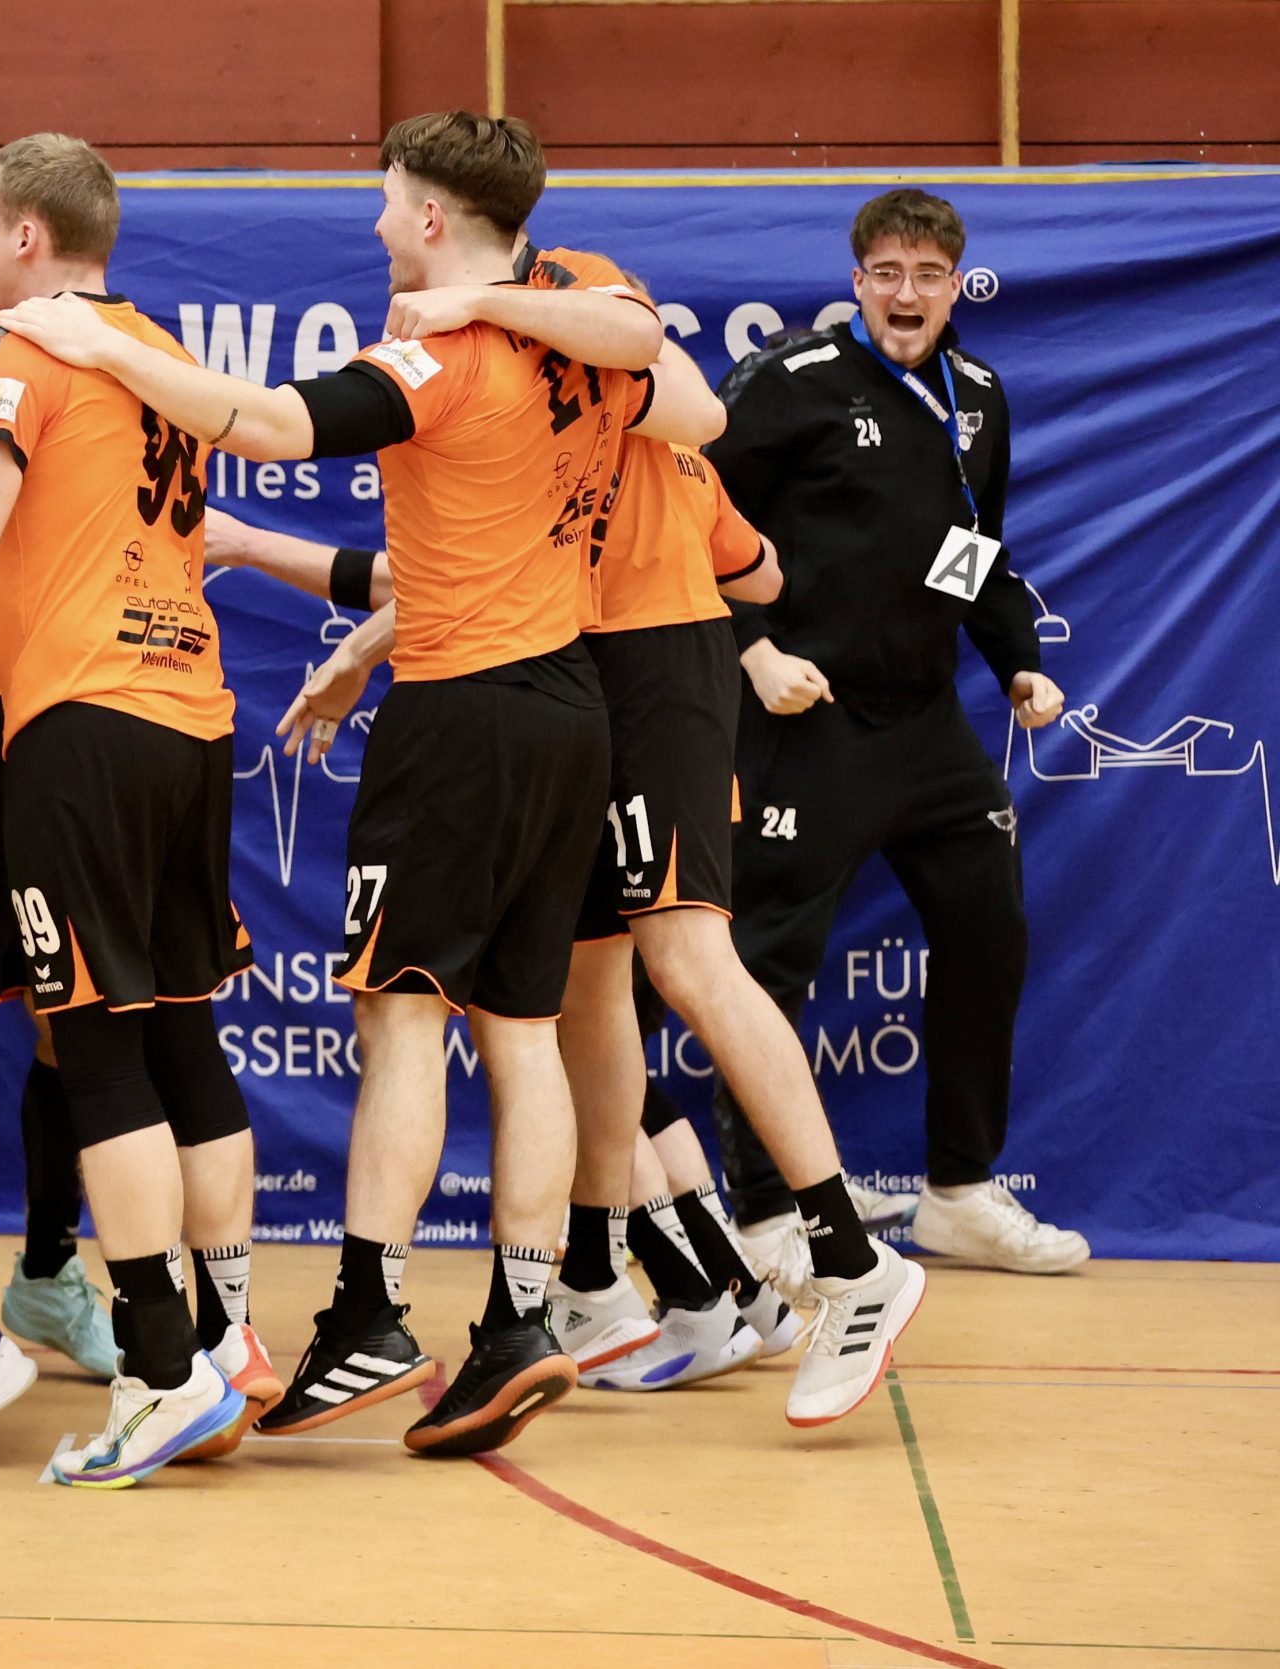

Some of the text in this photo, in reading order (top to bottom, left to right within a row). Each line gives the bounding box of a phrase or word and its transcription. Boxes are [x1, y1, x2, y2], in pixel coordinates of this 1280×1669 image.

[854, 417, 881, 447] 24
[216, 451, 381, 500] lles a
[115, 574, 148, 588] OPEL
[932, 542, 979, 597] A
[607, 794, 655, 868] 11
[761, 806, 797, 840] 24
[345, 864, 388, 935] 27
[623, 887, 651, 898] erima
[11, 886, 61, 957] 99
[35, 981, 64, 994] erima
[815, 1013, 920, 1077] MÖ
[254, 1170, 317, 1192] ser.de
[439, 1172, 492, 1196] @we
[309, 1219, 345, 1240] Wo
